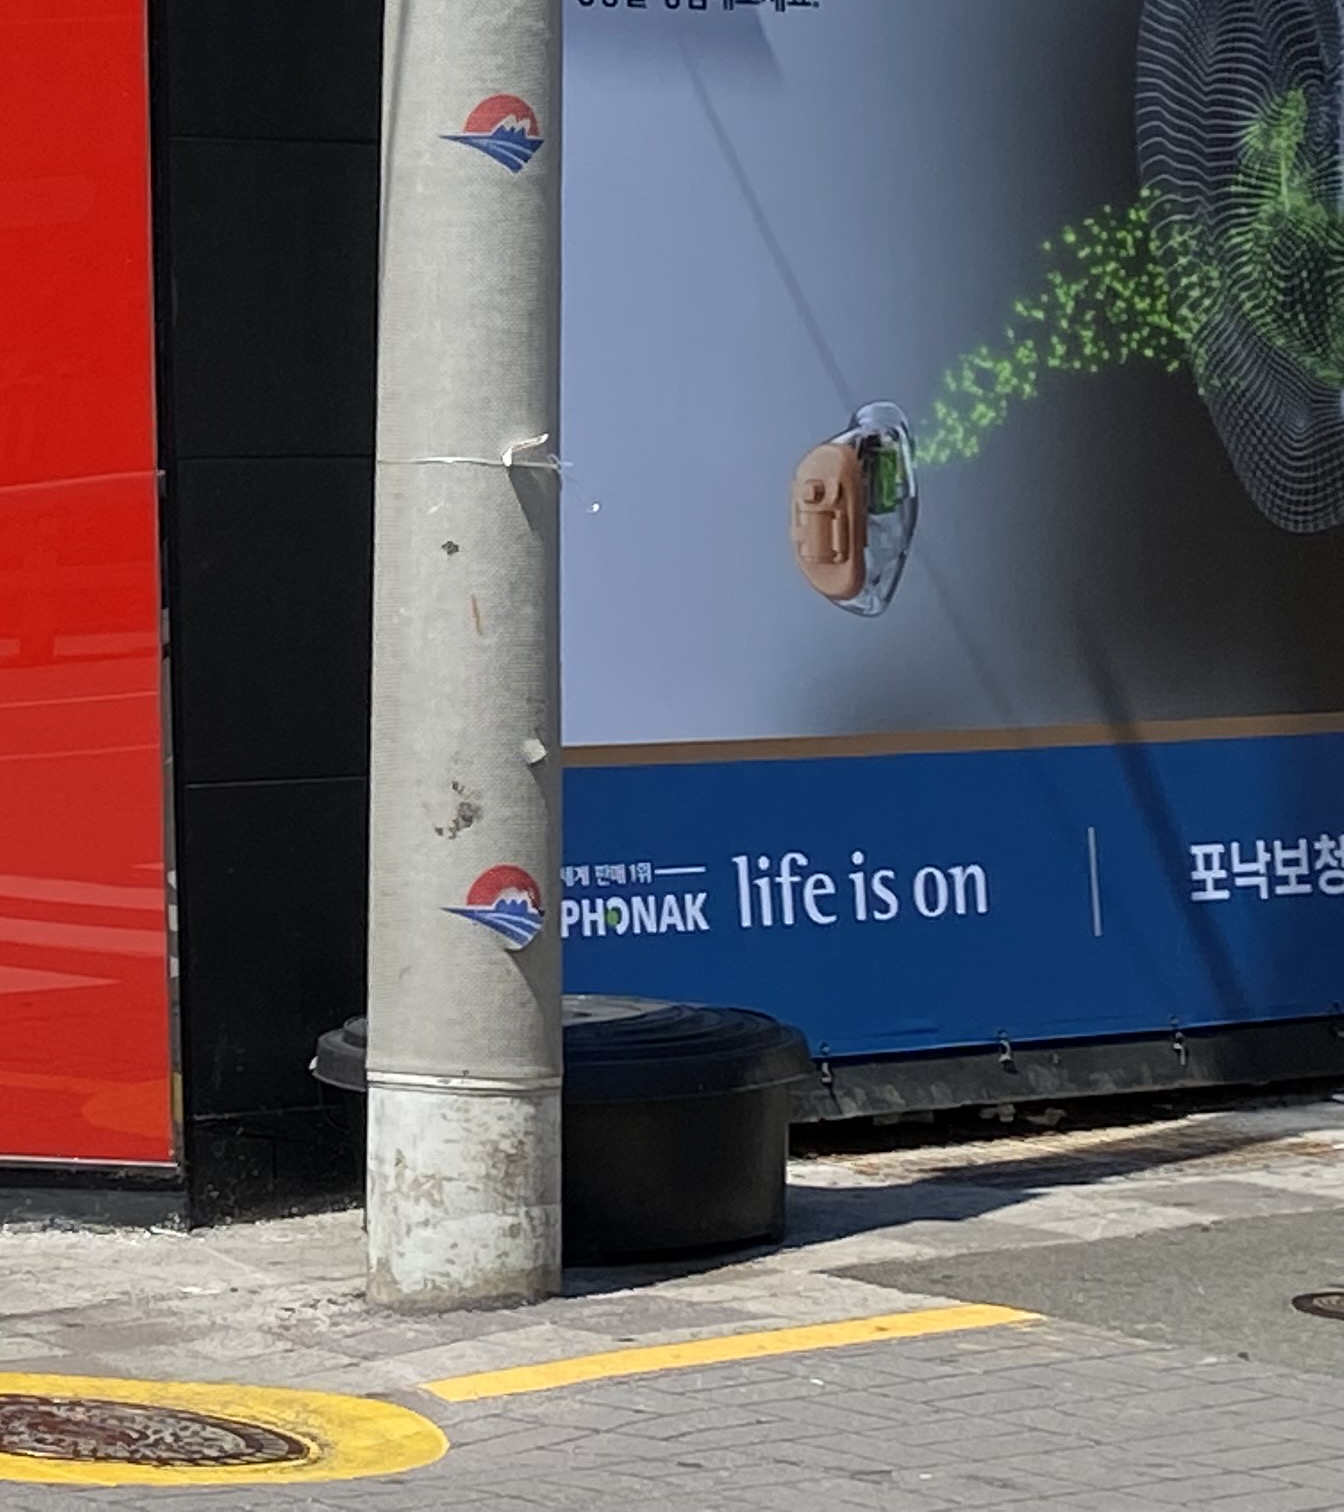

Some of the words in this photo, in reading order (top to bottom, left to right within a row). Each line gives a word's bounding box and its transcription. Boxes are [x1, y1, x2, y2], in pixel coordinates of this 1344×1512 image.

[560, 892, 711, 939] PHONAK
[731, 850, 839, 929] life
[848, 849, 900, 923] is
[912, 862, 990, 919] on
